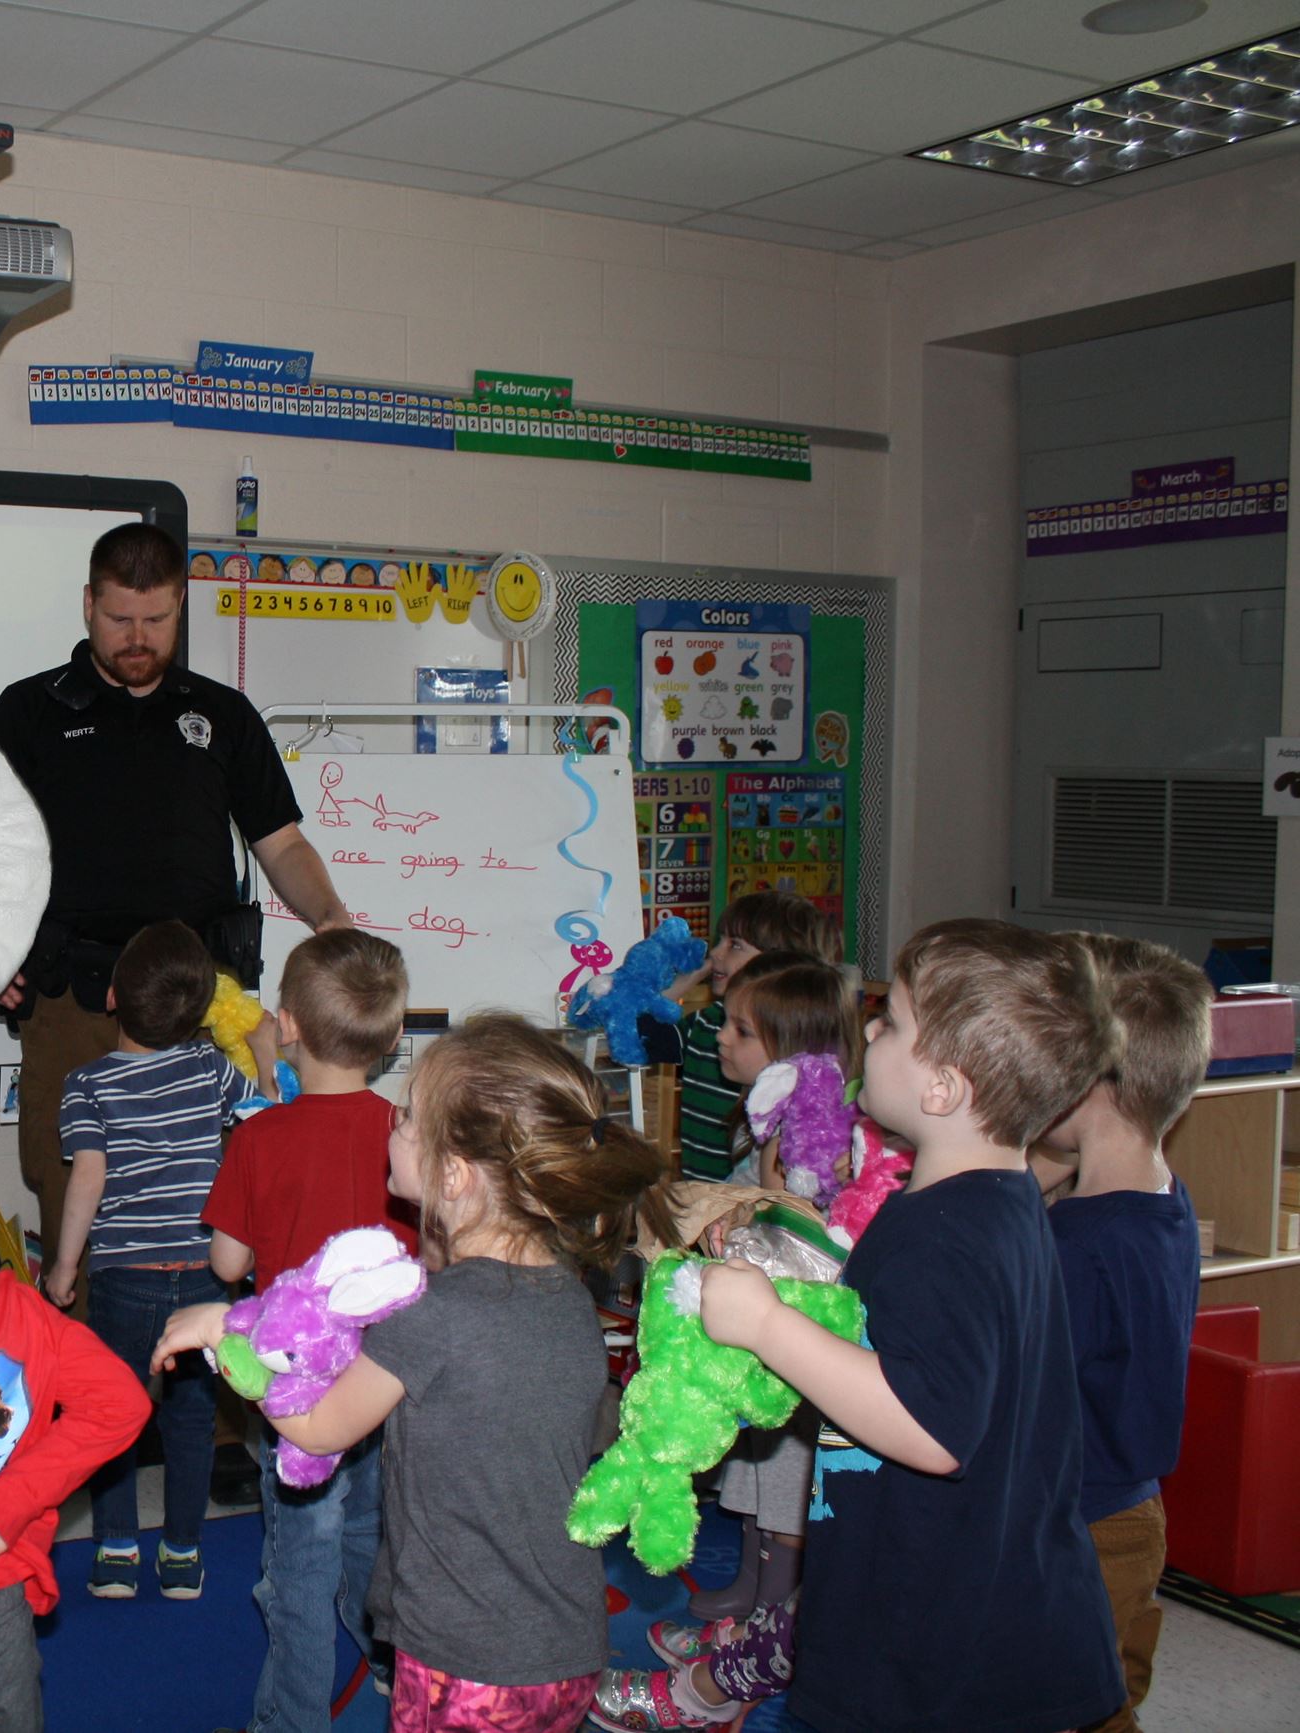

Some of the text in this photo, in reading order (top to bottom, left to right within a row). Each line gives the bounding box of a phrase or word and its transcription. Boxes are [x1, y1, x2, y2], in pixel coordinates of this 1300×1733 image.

[224, 352, 284, 375] January
[494, 380, 552, 401] February
[162, 386, 171, 396] 10
[232, 397, 241, 406] 15
[246, 398, 255, 408] 16
[260, 399, 269, 409] 17
[274, 401, 283, 410] 18
[288, 401, 297, 411] 19
[300, 403, 311, 413] 20
[314, 404, 323, 413] 21
[328, 406, 338, 414] 22
[341, 406, 352, 415] 23
[355, 407, 365, 416] 24
[369, 409, 379, 418] 25
[382, 410, 393, 419] 26
[396, 411, 405, 420] 27
[408, 412, 417, 421] 28
[420, 414, 430, 423] 29
[444, 417, 452, 426] 31
[1160, 470, 1201, 487] March
[222, 594, 392, 613] 0 2 3 4 5 6 7 8 9 10
[406, 596, 429, 610] LEFT
[447, 598, 471, 611] RIGHT
[701, 608, 750, 625] Colors
[654, 637, 792, 653] red orange blue pink
[653, 680, 690, 695] yellow
[734, 682, 764, 695] green
[771, 683, 794, 695] grey
[63, 726, 95, 739] WERTZ
[672, 724, 777, 738] purple brown black
[674, 777, 710, 795] 1-10
[733, 777, 842, 791] The Alphabet
[659, 803, 675, 824] 6
[659, 839, 674, 859] 7
[332, 847, 509, 879] are going to
[658, 860, 684, 868] SEVEN
[657, 873, 674, 894] 8
[657, 895, 679, 903] EIGHT
